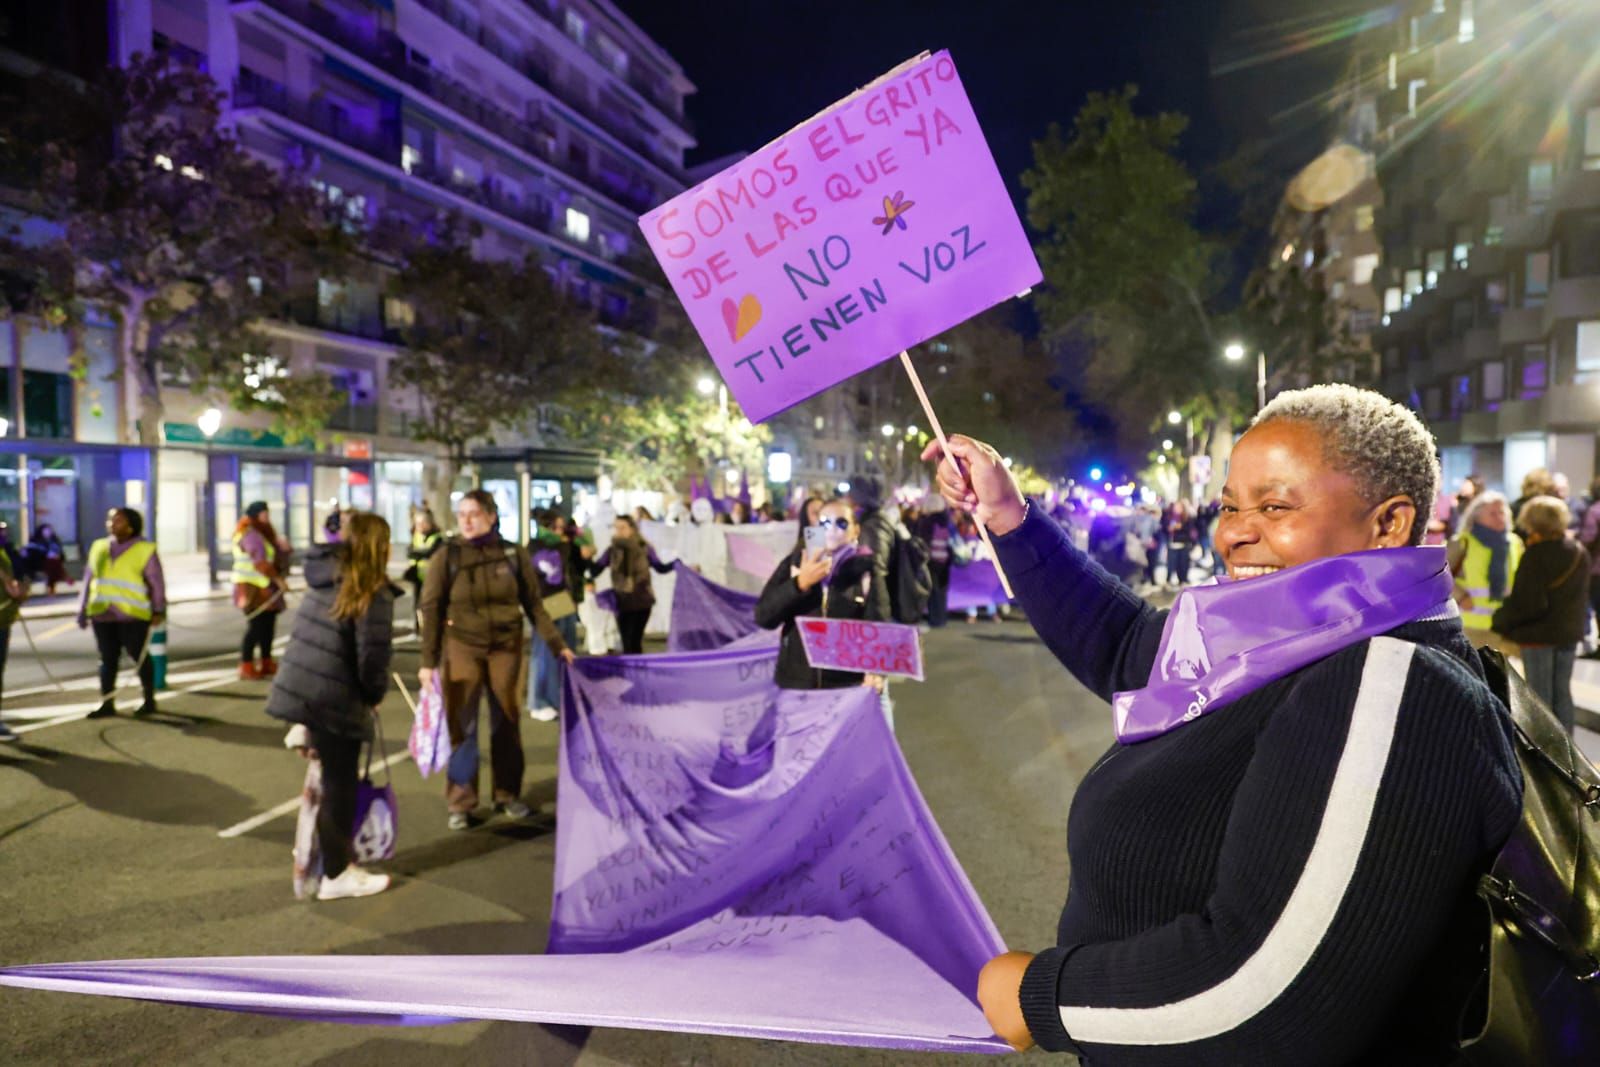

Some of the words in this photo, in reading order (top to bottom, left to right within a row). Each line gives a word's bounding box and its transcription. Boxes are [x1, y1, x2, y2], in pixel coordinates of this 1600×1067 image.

[656, 148, 798, 259] SOMOS
[808, 116, 865, 162] EL
[865, 57, 955, 126] GRITO
[681, 251, 737, 300] DE
[744, 196, 817, 258] LAS
[824, 147, 899, 203] QUE
[904, 107, 962, 155] YA
[734, 279, 888, 383] TIENEN
[898, 225, 987, 285] VOZ
[783, 235, 851, 300] NO
[839, 621, 879, 642] NO
